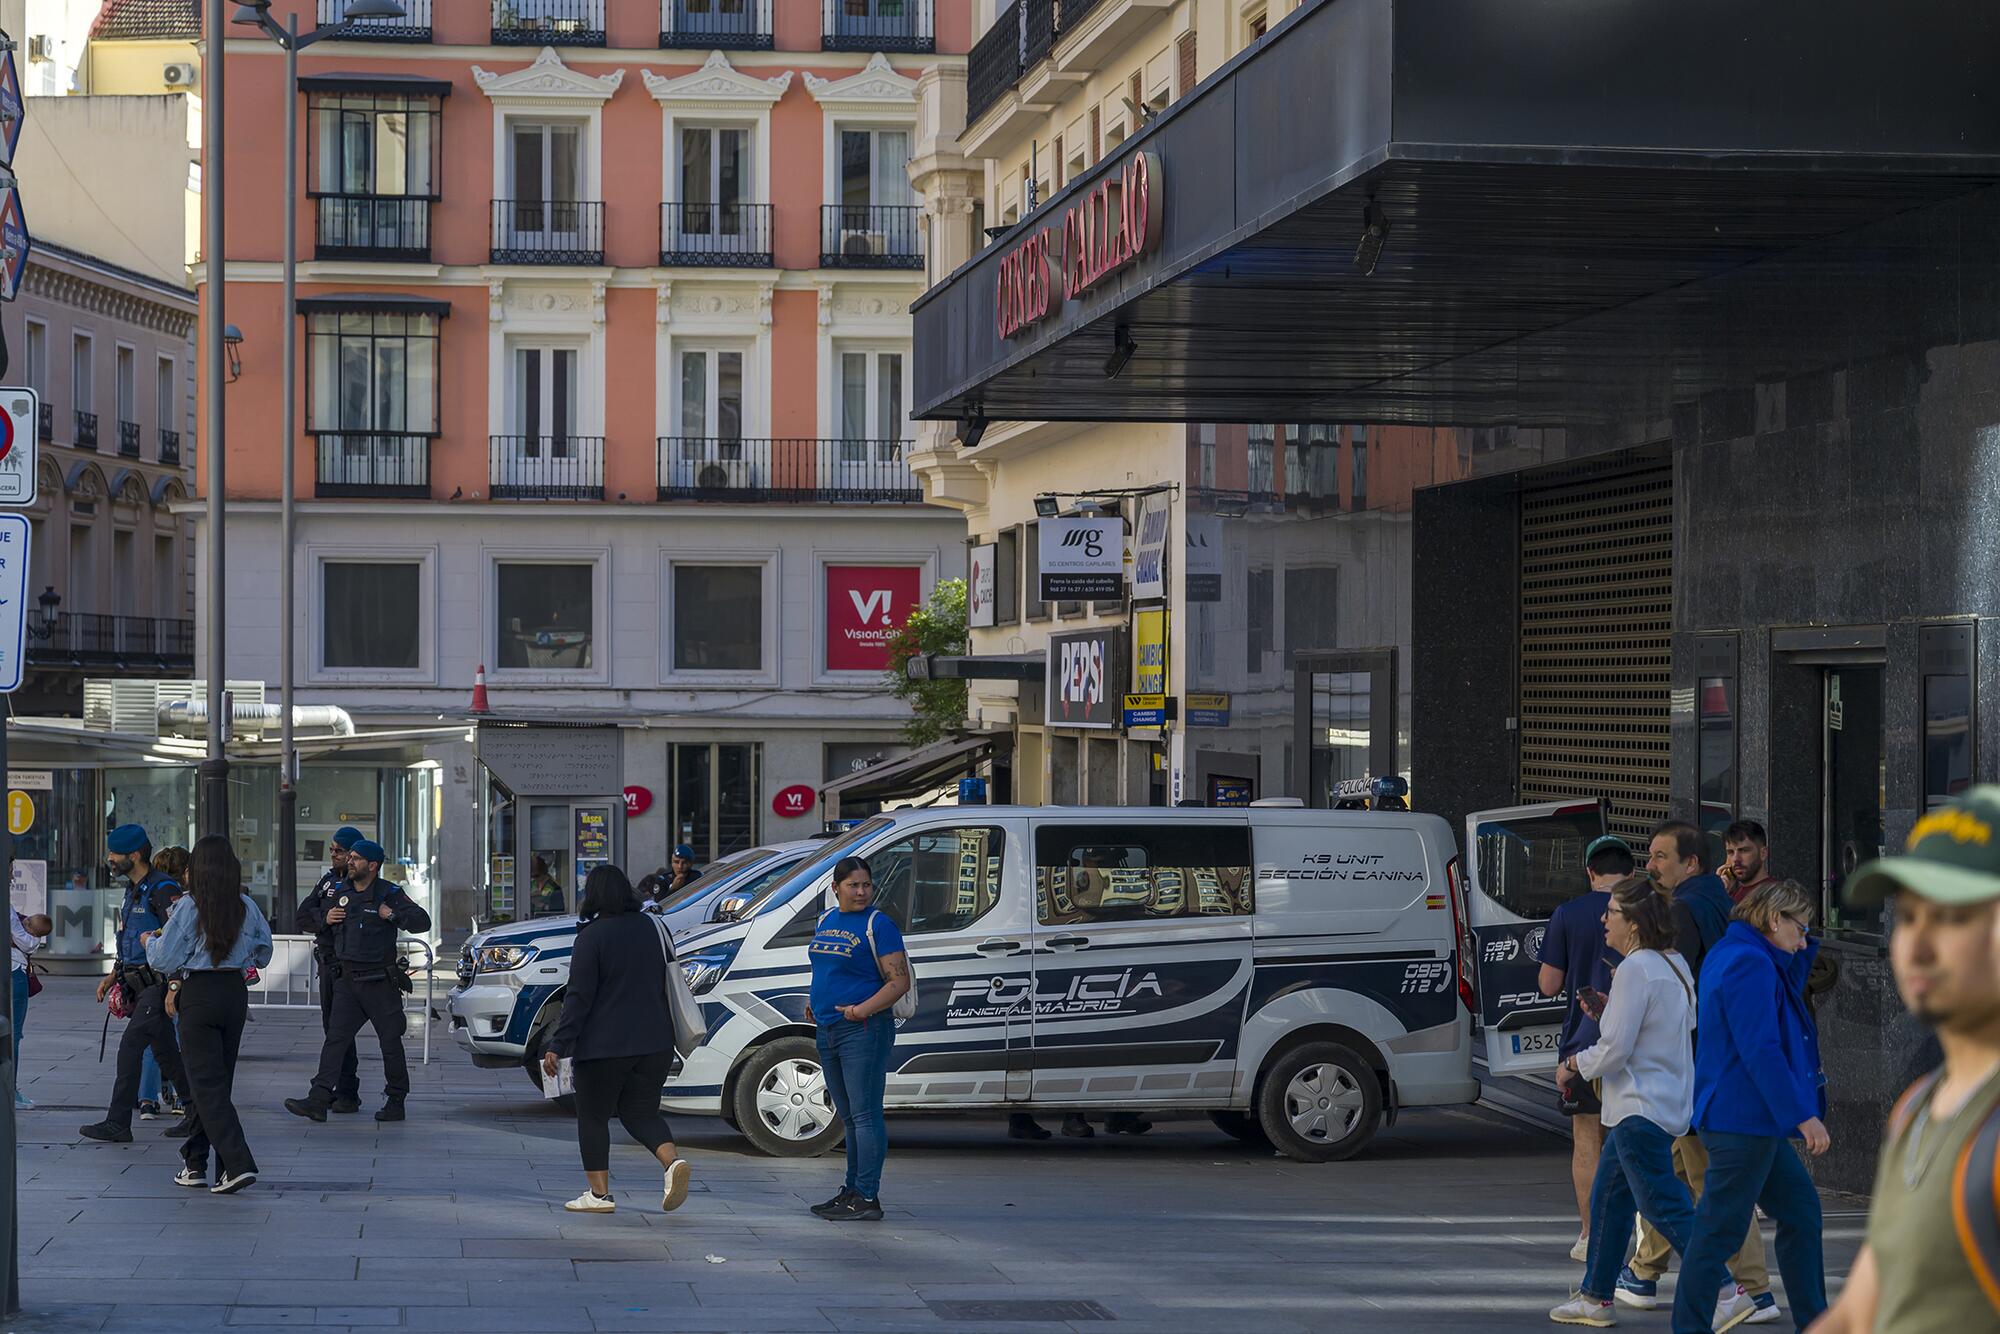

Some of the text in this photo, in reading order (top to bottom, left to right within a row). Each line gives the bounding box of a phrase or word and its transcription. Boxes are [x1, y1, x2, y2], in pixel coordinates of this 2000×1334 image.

[997, 150, 1148, 340] CINES CALLAO
[1136, 549, 1160, 584] CHANGE
[844, 628, 902, 639] VisionLab
[1061, 639, 1105, 704] PEPSI
[1302, 854, 1384, 865] K9 UNIT
[1258, 867, 1424, 881] SECCIÓN CANINA
[1485, 941, 1512, 953] 092
[1484, 951, 1505, 962] 112
[1404, 963, 1444, 979] 092
[1400, 980, 1431, 994] 112
[1498, 990, 1567, 1007] POLIC
[1035, 1000, 1122, 1014] MADRID
